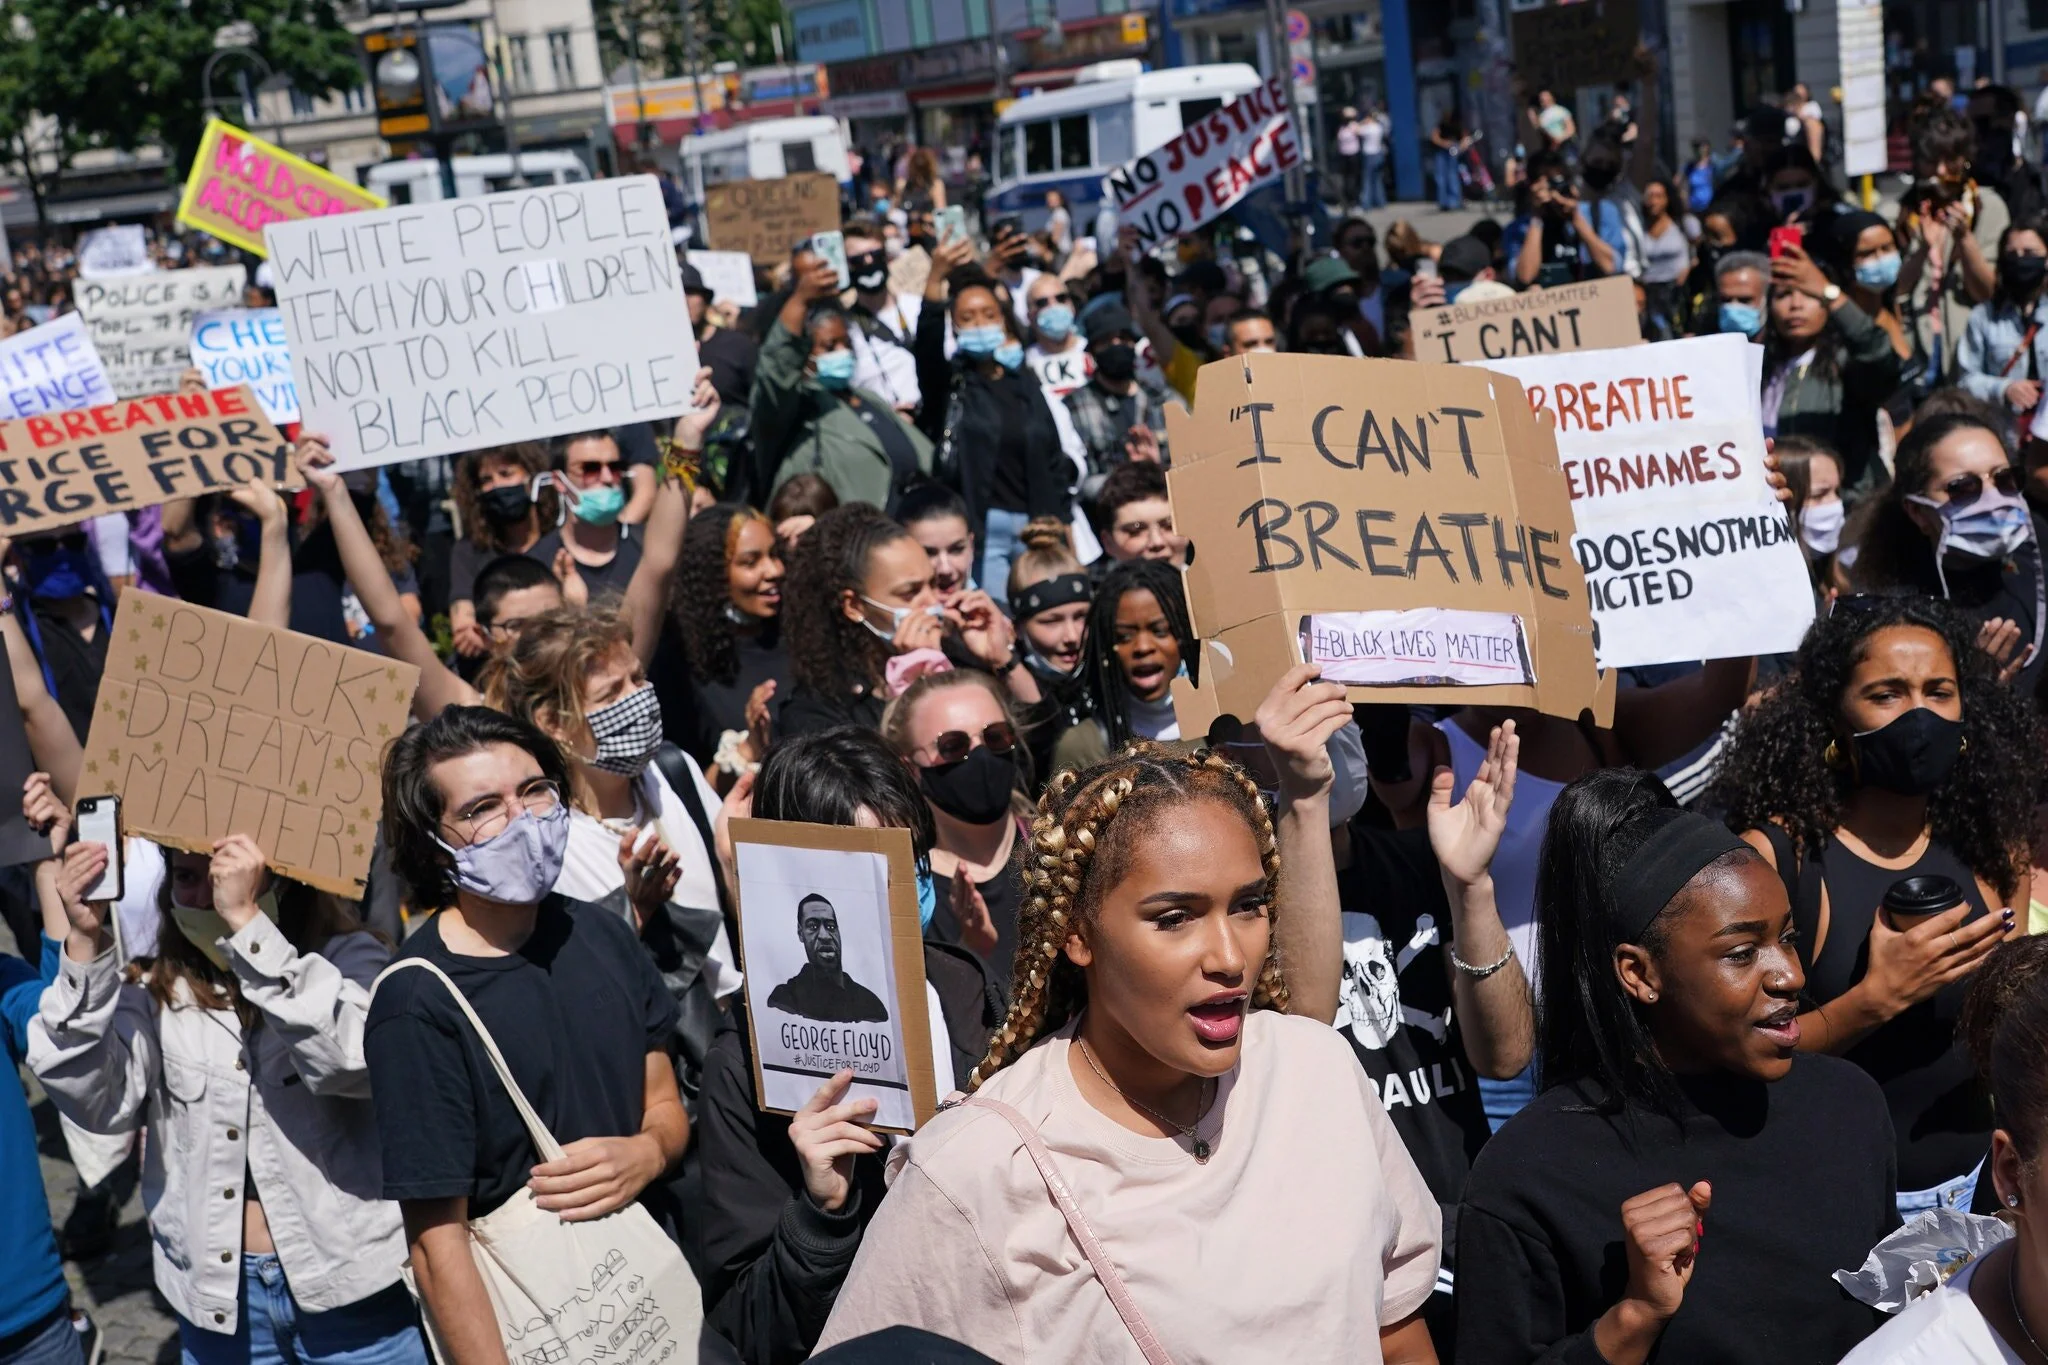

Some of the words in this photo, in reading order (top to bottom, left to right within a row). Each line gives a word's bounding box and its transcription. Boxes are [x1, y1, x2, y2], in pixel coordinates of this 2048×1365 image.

[1110, 157, 1159, 204] NO
[1164, 76, 1288, 173] JUSTICE
[1130, 201, 1182, 252] NO
[1183, 121, 1298, 222] PEACE
[270, 216, 431, 285] WHITE
[453, 184, 665, 257] PEOPLE,
[83, 283, 179, 309] POLICE
[191, 283, 210, 300] IS
[222, 280, 237, 298] A
[504, 246, 673, 314] CHILDREN
[304, 343, 386, 407] NOT
[394, 334, 450, 387] TO
[468, 322, 579, 376] KILL
[1479, 308, 1581, 360] CAN'T
[26, 386, 249, 448] BREATHE
[140, 419, 271, 460] FOR
[349, 388, 503, 455] BLACK
[517, 355, 682, 425] PEOPLE
[1311, 404, 1485, 480] CAN'T
[1236, 497, 1570, 600] BREATHE"
[158, 608, 385, 736] BLACK
[1313, 628, 1386, 658] #BLACK
[1391, 630, 1437, 658] LIVES
[1445, 633, 1516, 665] MATTER
[126, 678, 374, 804] DREAMS
[121, 752, 346, 878] MATTER
[781, 1022, 839, 1055] GEORGE
[843, 1029, 891, 1062] FLOYD
